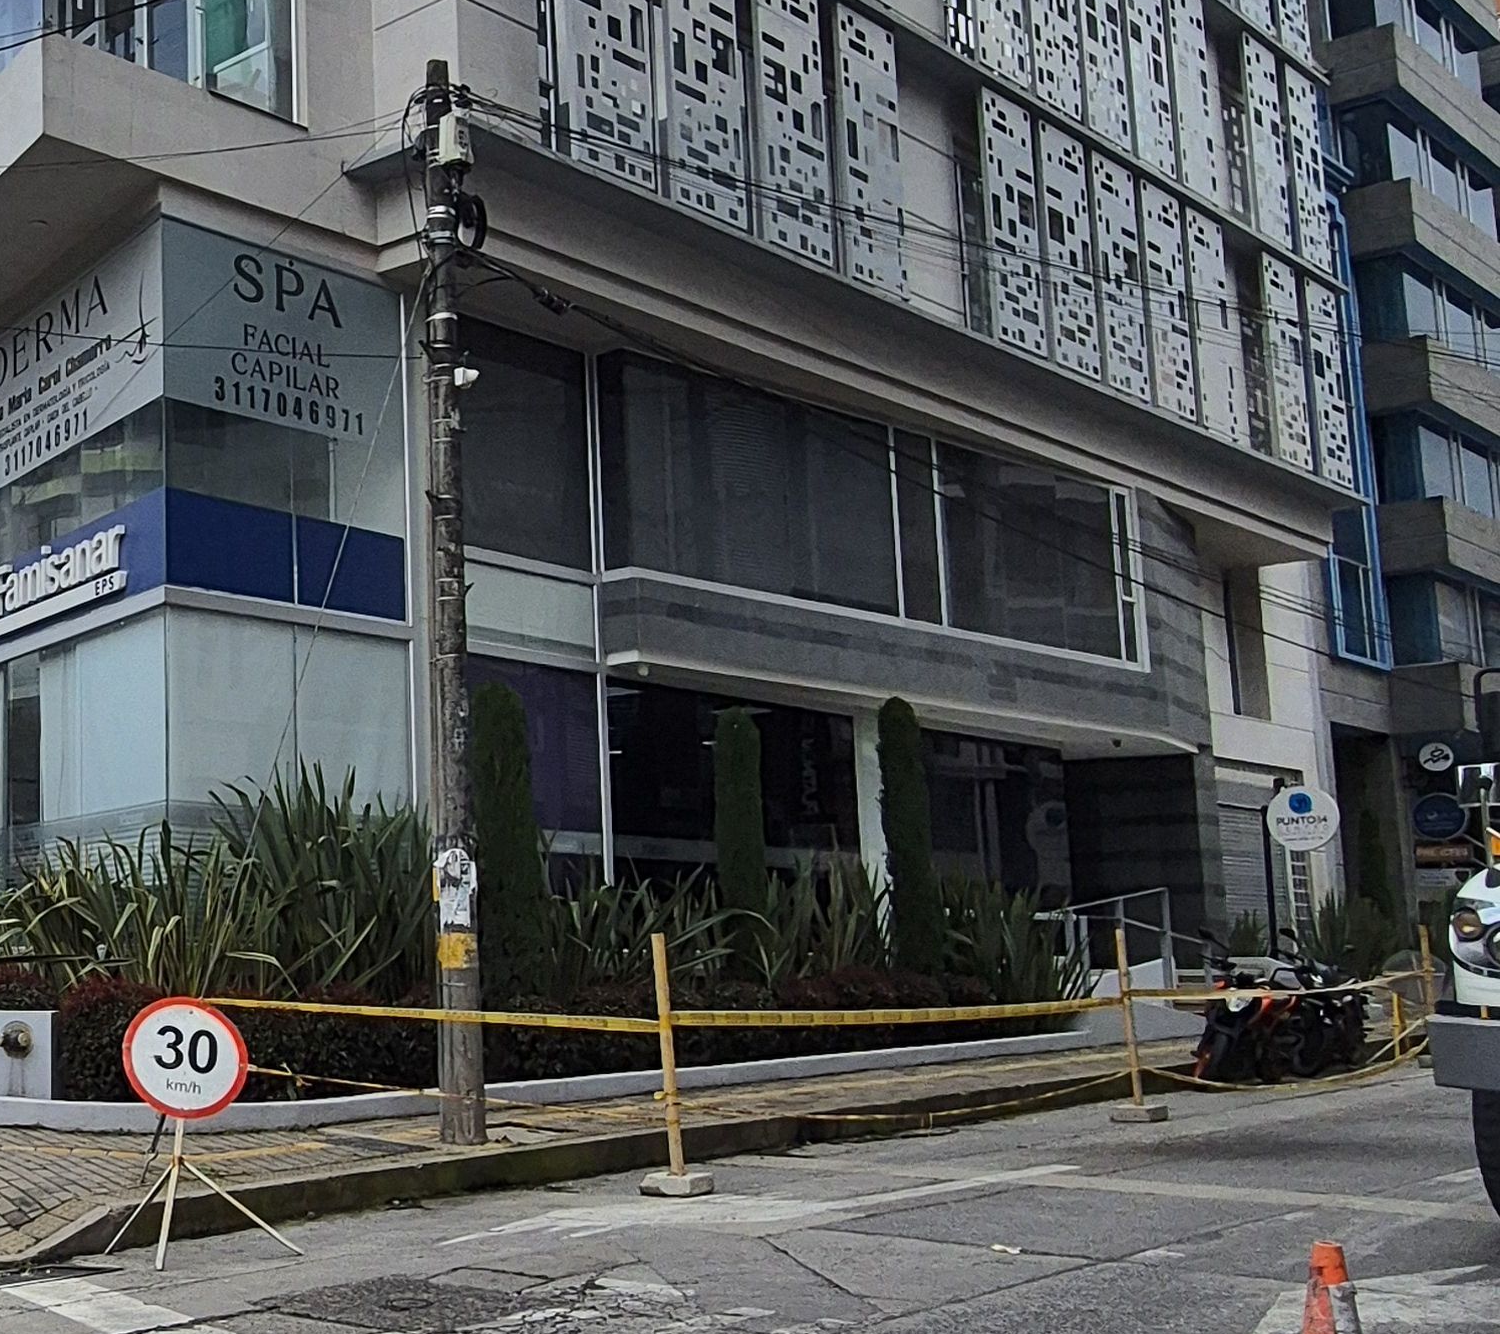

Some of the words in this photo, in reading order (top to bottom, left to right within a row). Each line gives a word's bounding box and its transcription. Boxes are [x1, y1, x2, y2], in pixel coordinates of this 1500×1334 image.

[233, 253, 343, 329] SPA
[243, 323, 331, 369] FACIAL
[231, 351, 340, 400] CAPILAR
[214, 376, 364, 436] 3117046971
[4, 407, 88, 476] 3117046971
[94, 575, 115, 597] EPS
[153, 1025, 218, 1075] 30
[165, 1078, 202, 1095] km/h
